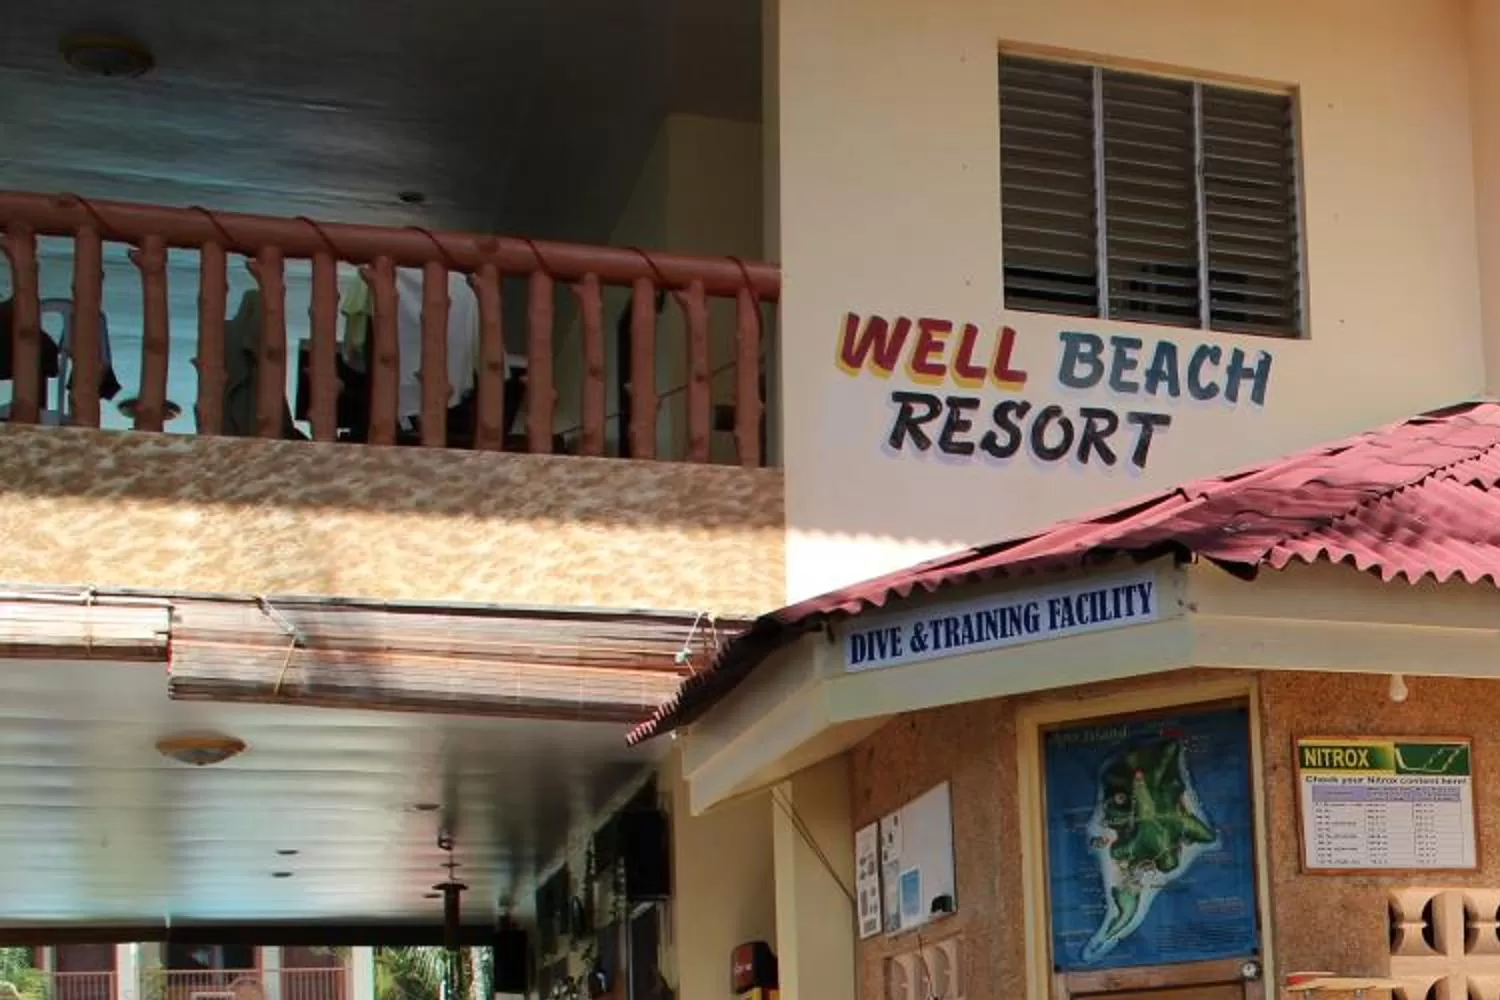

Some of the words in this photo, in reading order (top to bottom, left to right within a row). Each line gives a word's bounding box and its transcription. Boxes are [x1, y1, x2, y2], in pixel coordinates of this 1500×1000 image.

[837, 312, 1027, 389] WELL
[1058, 331, 1273, 406] BEACH
[887, 391, 1172, 469] RESORT
[850, 627, 902, 665] DIVE
[1048, 581, 1153, 629] FACILITY
[1304, 747, 1370, 768] NITROX
